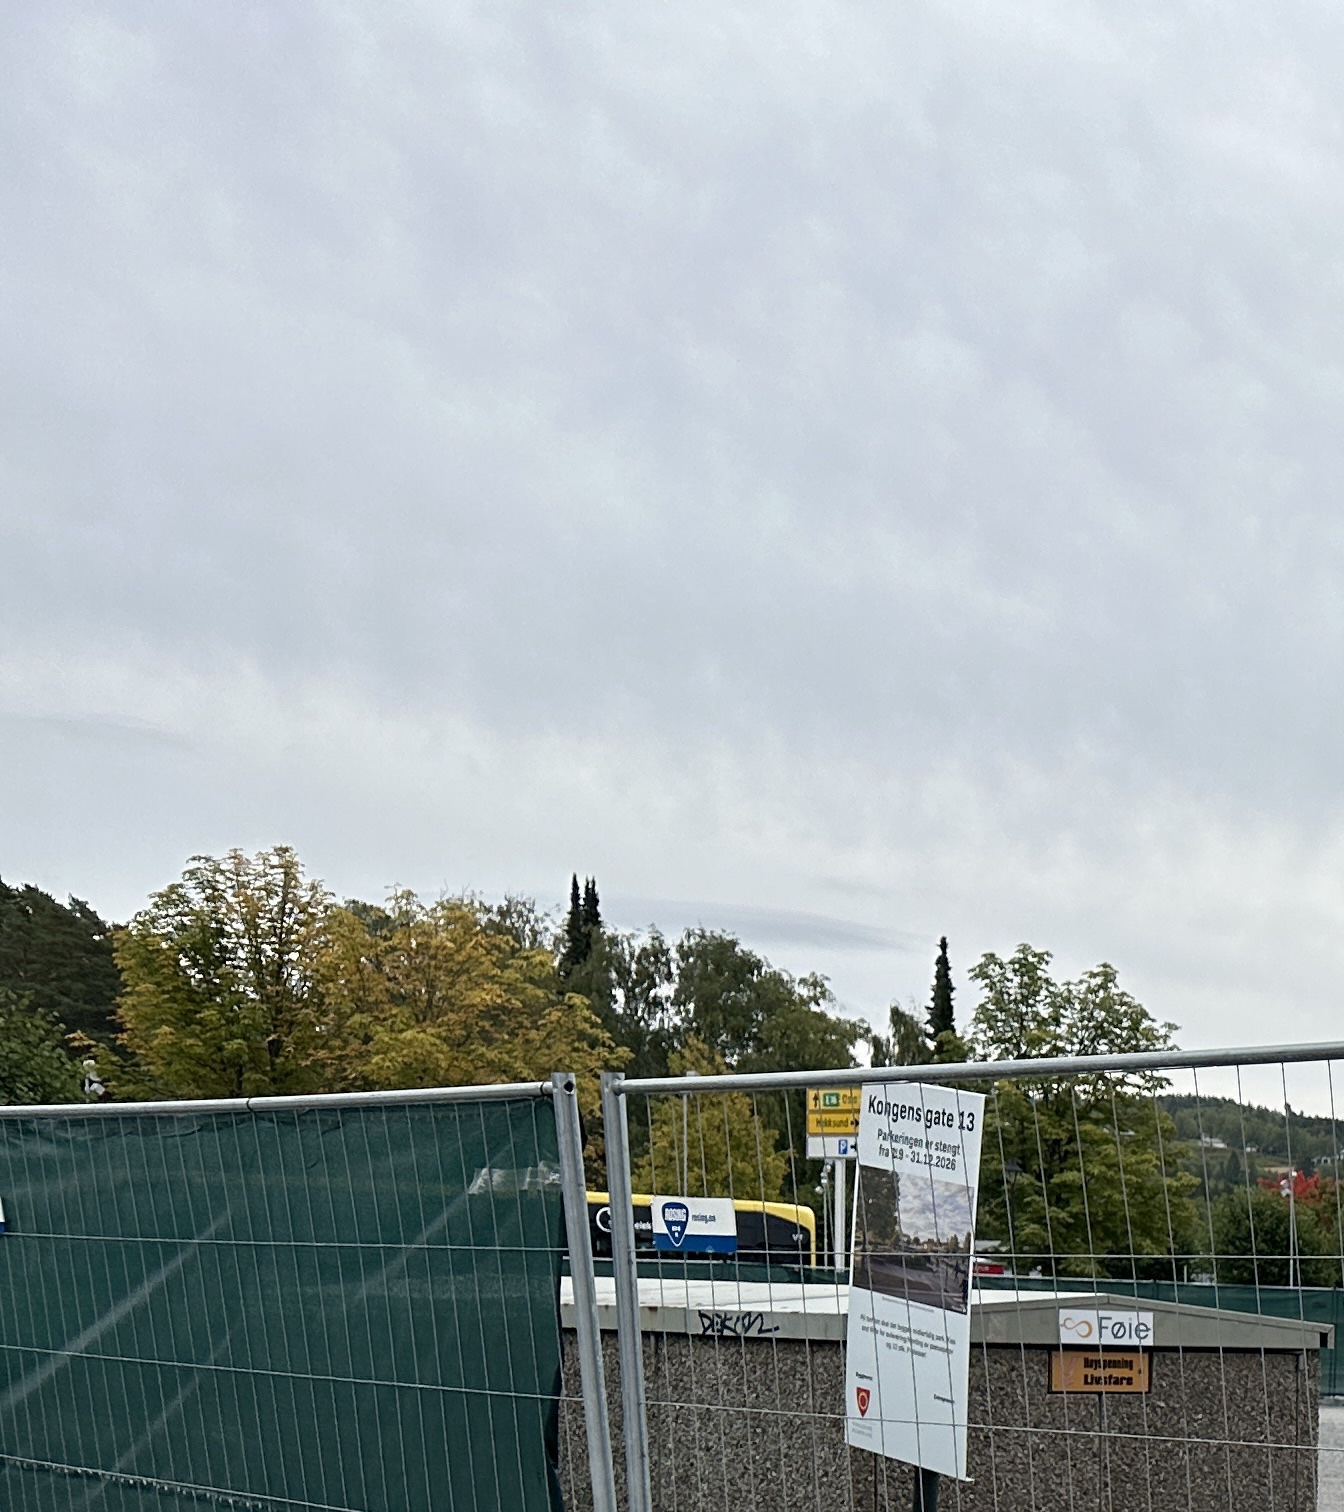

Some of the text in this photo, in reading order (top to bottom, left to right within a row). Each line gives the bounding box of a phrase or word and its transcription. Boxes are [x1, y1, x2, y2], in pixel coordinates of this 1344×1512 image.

[868, 1094, 976, 1132] Kongens gate 13
[877, 1128, 923, 1150] Parkeringen
[934, 1140, 961, 1157] stengt
[878, 1144, 890, 1158] fra
[910, 1150, 957, 1171] 31.12.2026
[1099, 1316, 1151, 1340] Føie
[1083, 1373, 1134, 1386] Livsfare
